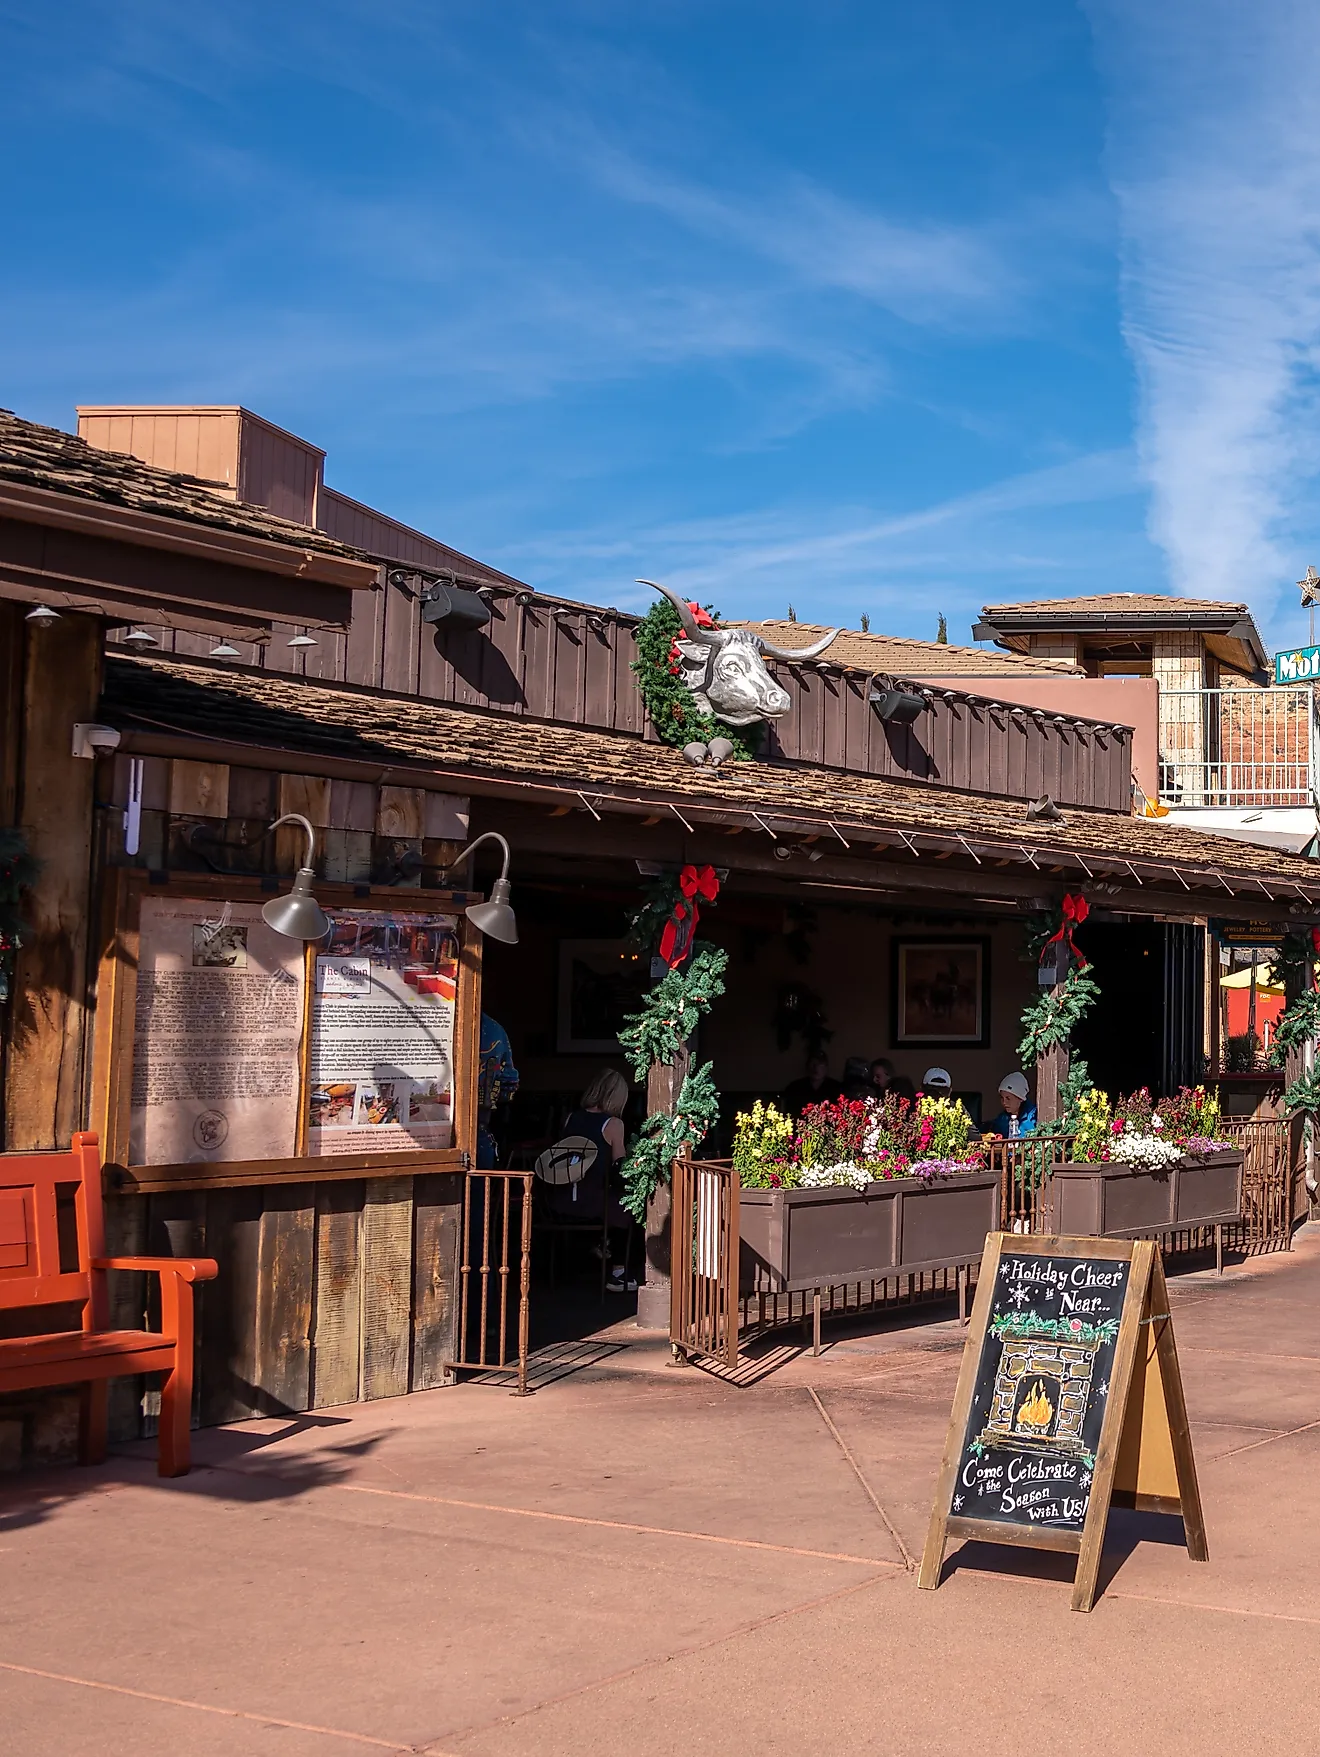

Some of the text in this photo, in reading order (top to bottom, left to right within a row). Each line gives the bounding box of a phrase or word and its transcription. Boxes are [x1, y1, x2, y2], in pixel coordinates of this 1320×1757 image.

[318, 964, 369, 977] The Cabin
[1010, 1259, 1123, 1290] Holiday Cheer
[963, 1456, 1077, 1487] Come Celebrate
[986, 1479, 1050, 1513] the Season
